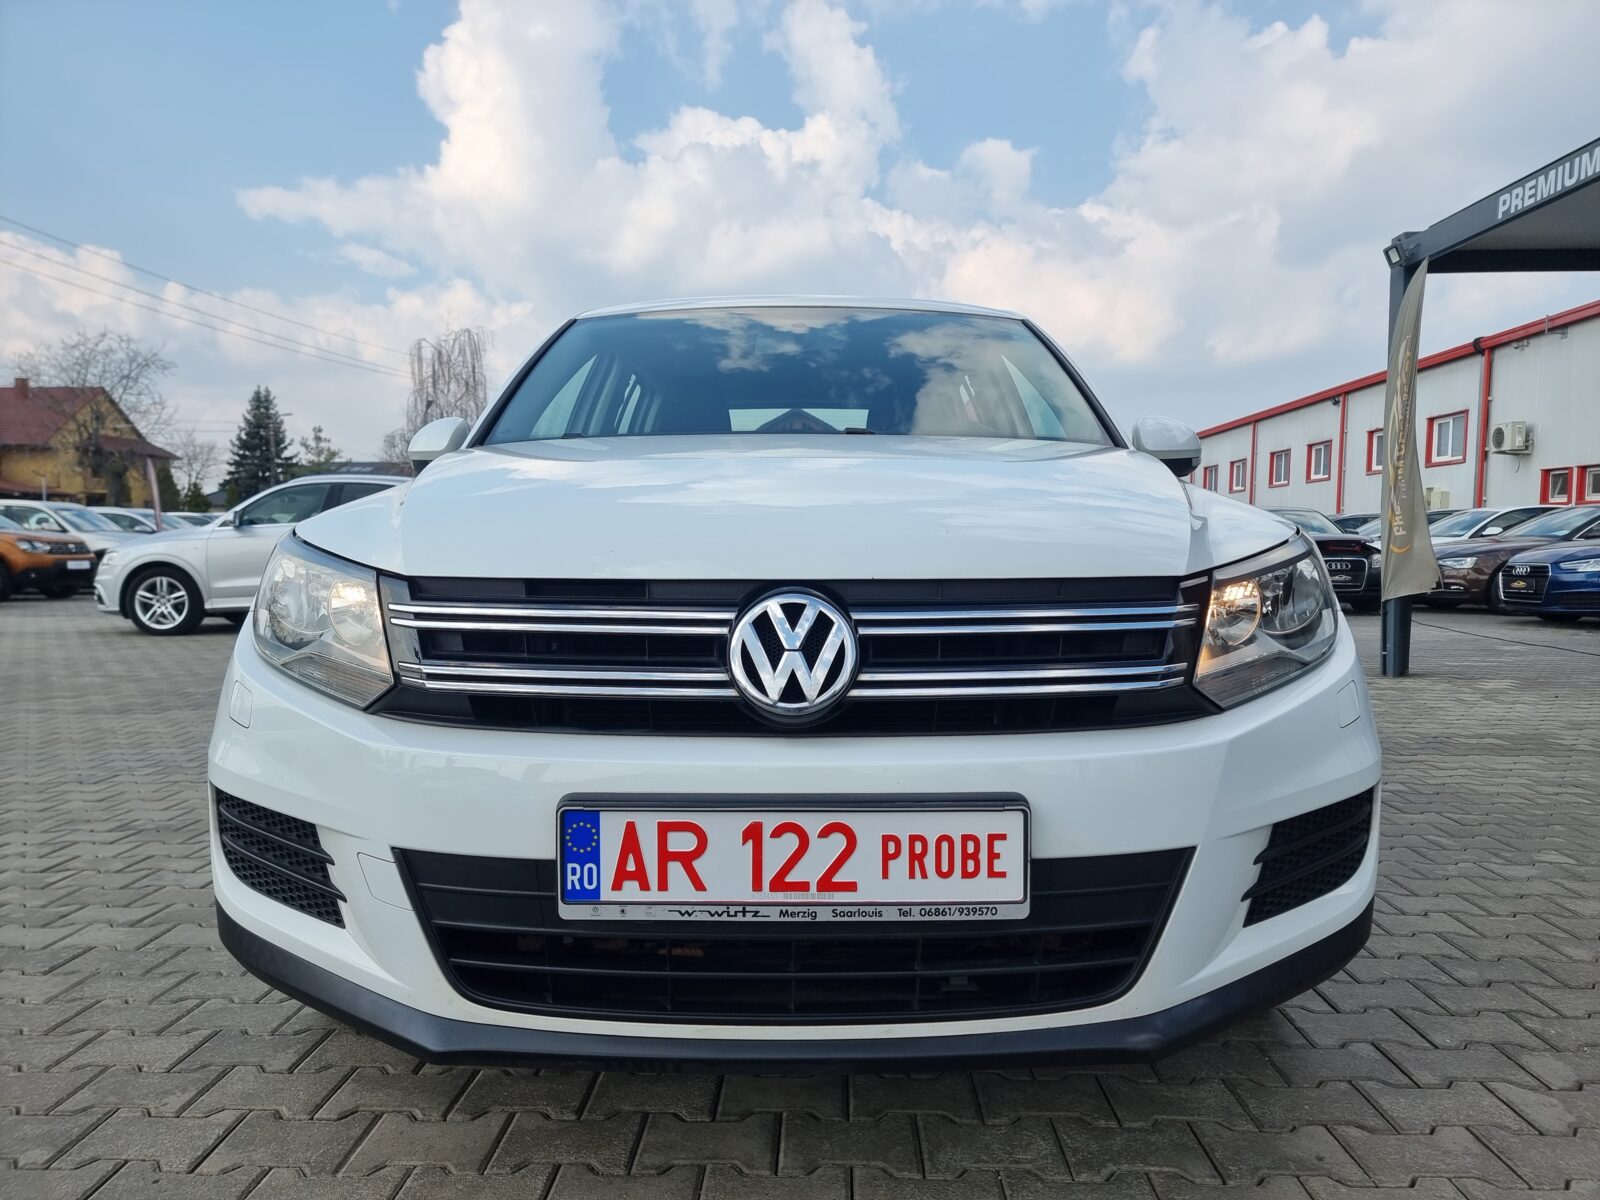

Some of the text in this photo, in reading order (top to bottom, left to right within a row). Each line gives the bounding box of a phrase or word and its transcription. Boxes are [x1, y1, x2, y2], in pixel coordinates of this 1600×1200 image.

[1498, 146, 1600, 219] PREMIUM
[567, 863, 598, 890] RO
[611, 820, 1007, 892] AR 122 PROBE
[778, 908, 818, 920] Merzig
[831, 908, 883, 918] Saarlouis
[897, 907, 916, 918] Tel.
[919, 906, 998, 917] 06861/939570
